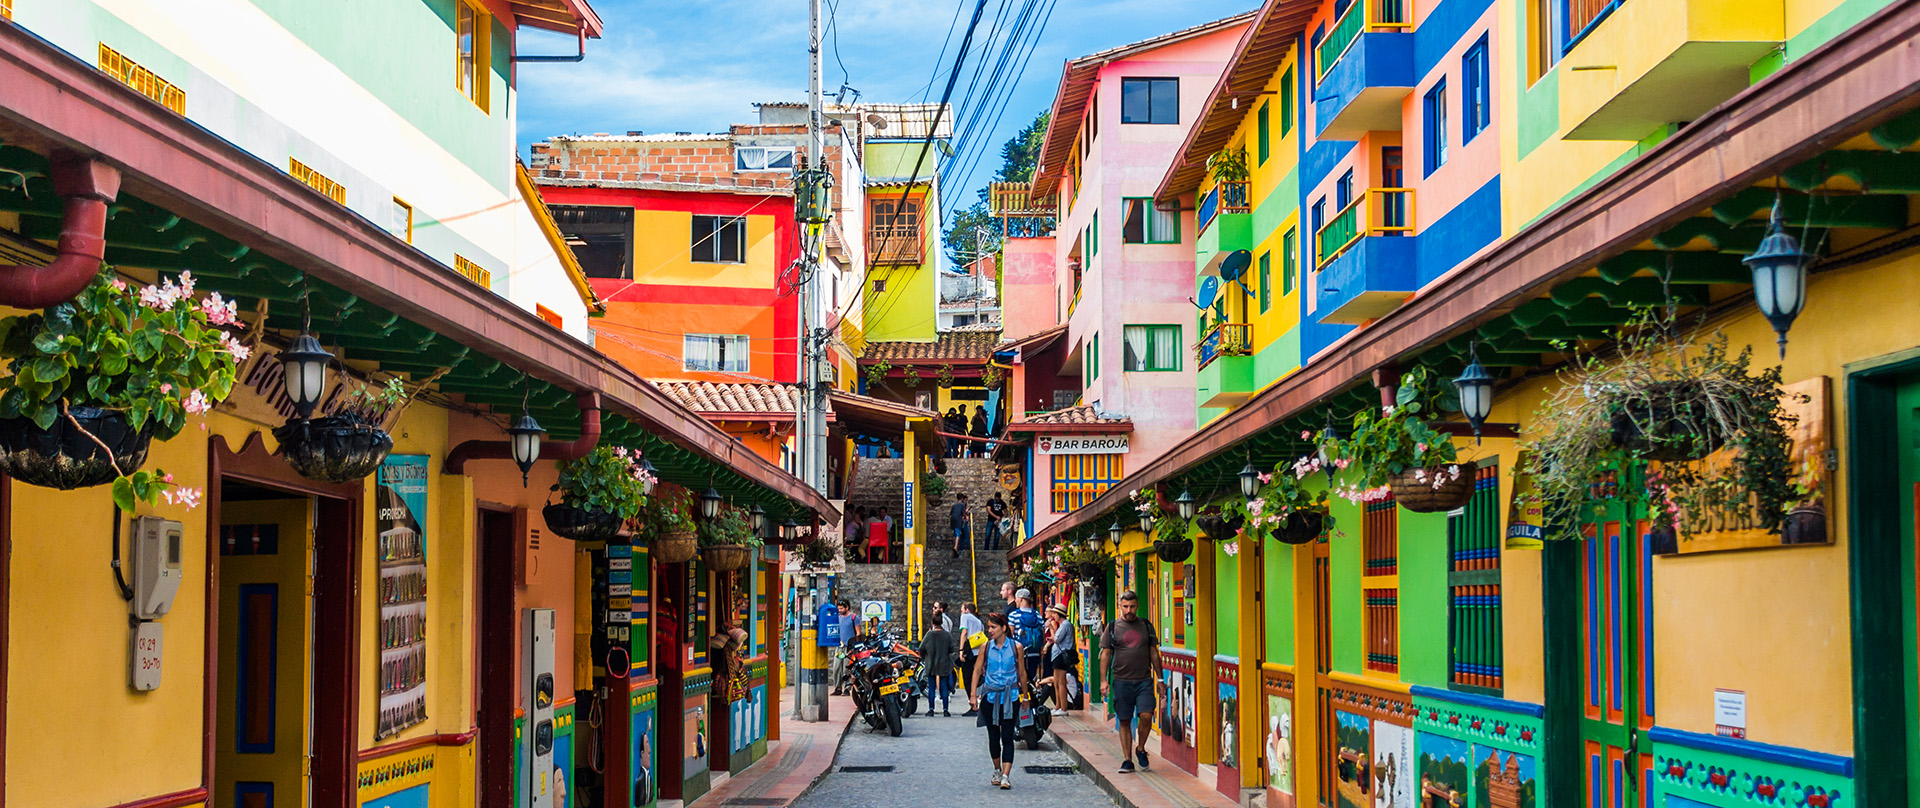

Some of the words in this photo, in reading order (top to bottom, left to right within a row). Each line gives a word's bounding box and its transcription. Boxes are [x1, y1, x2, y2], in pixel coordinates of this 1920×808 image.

[1054, 439, 1079, 450] BAR
[1081, 438, 1129, 450] BAROJA
[147, 638, 156, 652] 29
